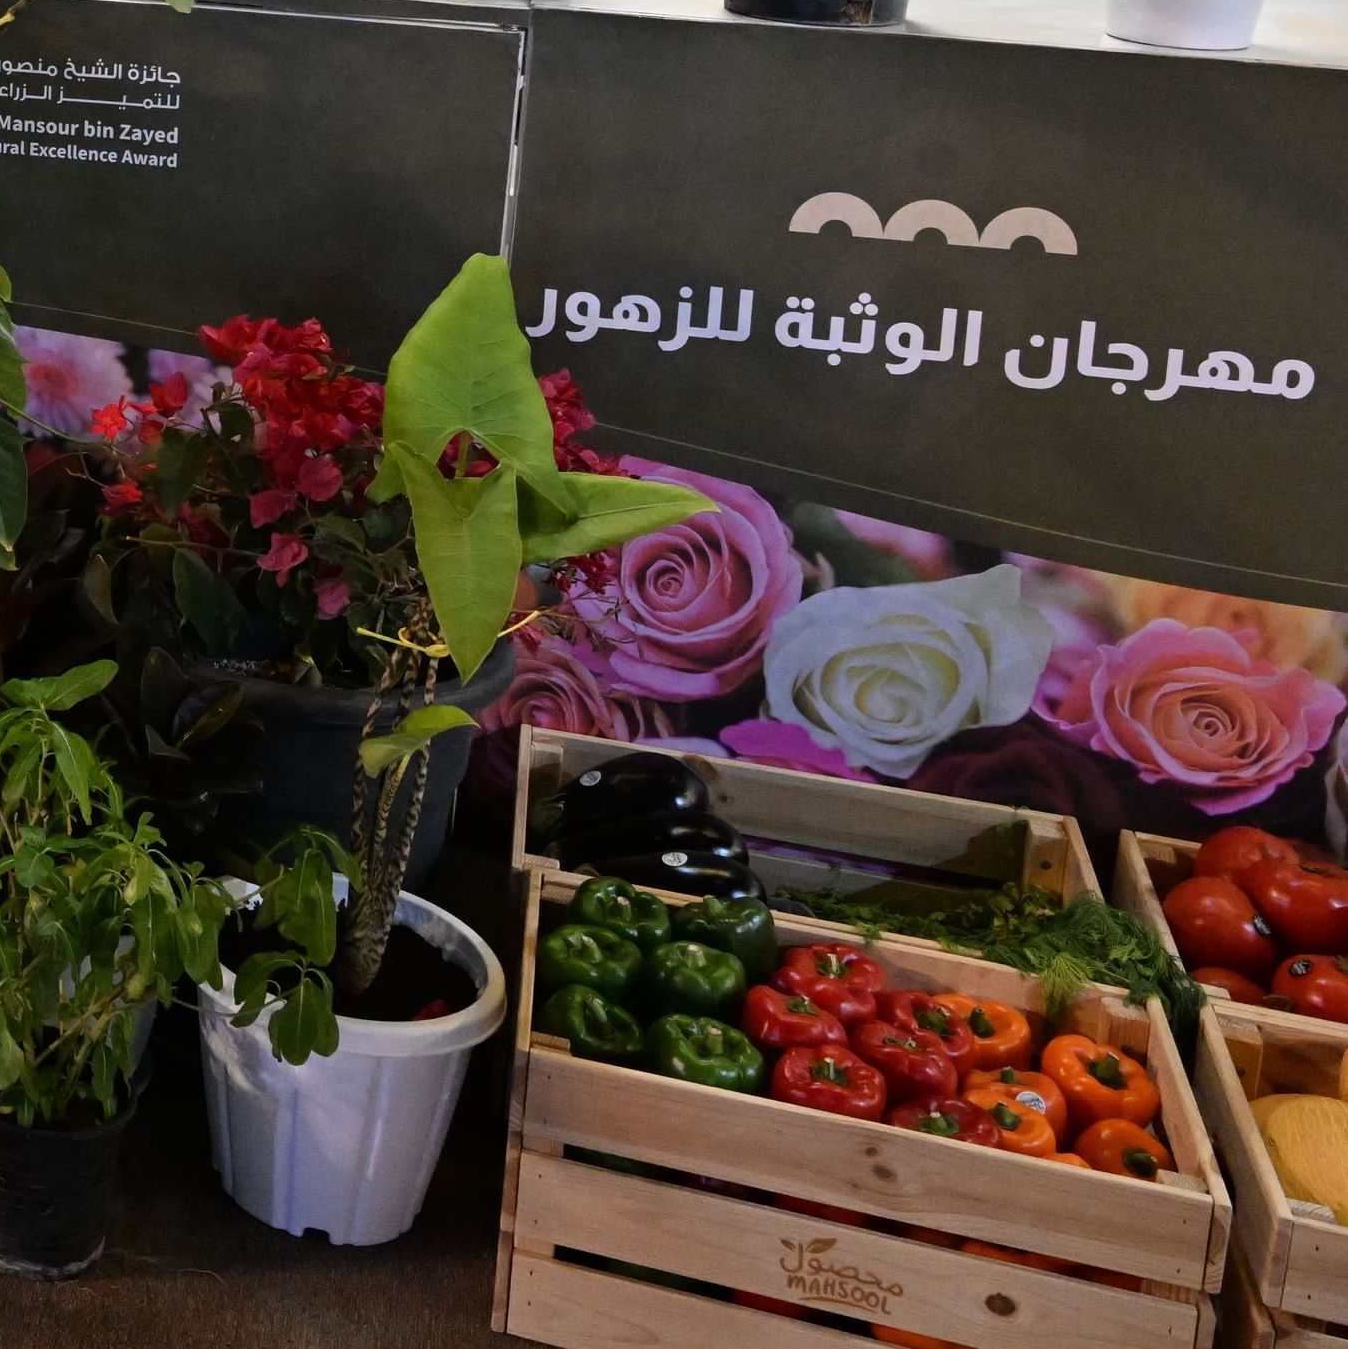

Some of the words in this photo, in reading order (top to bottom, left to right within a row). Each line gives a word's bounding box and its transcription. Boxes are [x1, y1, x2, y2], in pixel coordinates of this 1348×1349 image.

[63, 57, 123, 82] الشيخ
[127, 62, 181, 88] جائزة
[83, 119, 114, 139] bin
[118, 124, 179, 146] Zayed
[29, 142, 118, 163] Excellence
[121, 149, 178, 168] Award
[525, 284, 755, 353] للزهور
[774, 291, 983, 376] الوثبة
[1004, 321, 1316, 402] مهرجان
[779, 1242, 904, 1297] محصول
[786, 1274, 892, 1315] MAHSOOL
